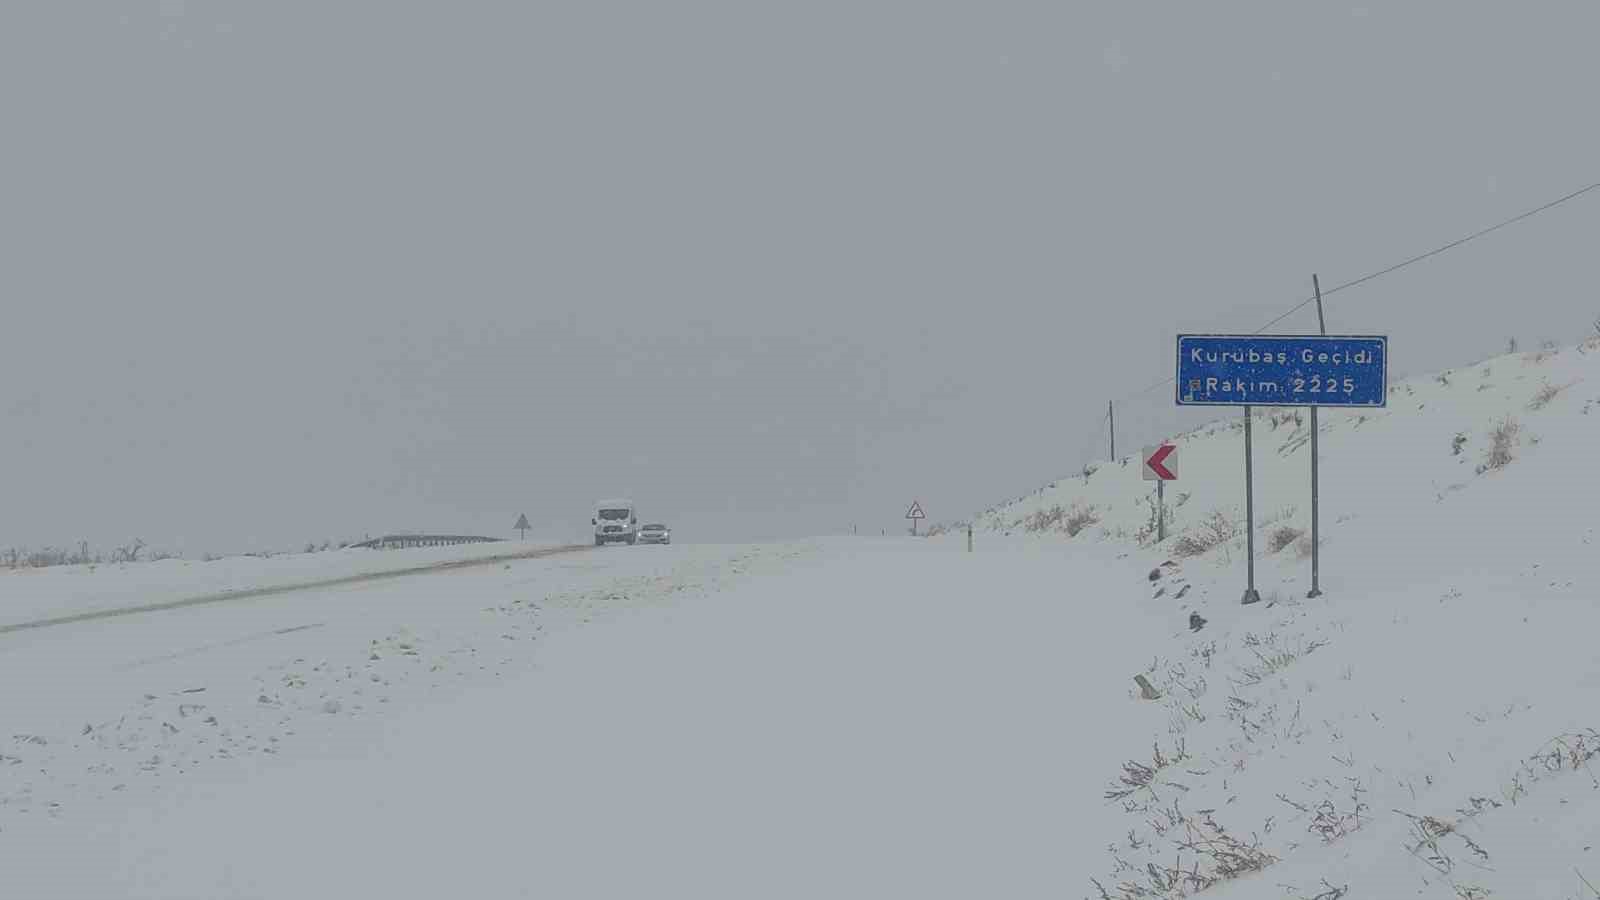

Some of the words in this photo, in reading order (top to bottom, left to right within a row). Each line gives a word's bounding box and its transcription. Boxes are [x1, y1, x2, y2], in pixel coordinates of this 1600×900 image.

[1191, 349, 1287, 365] Kurubaş
[1302, 349, 1372, 365] Geçidi
[1293, 378, 1354, 393] 2225
